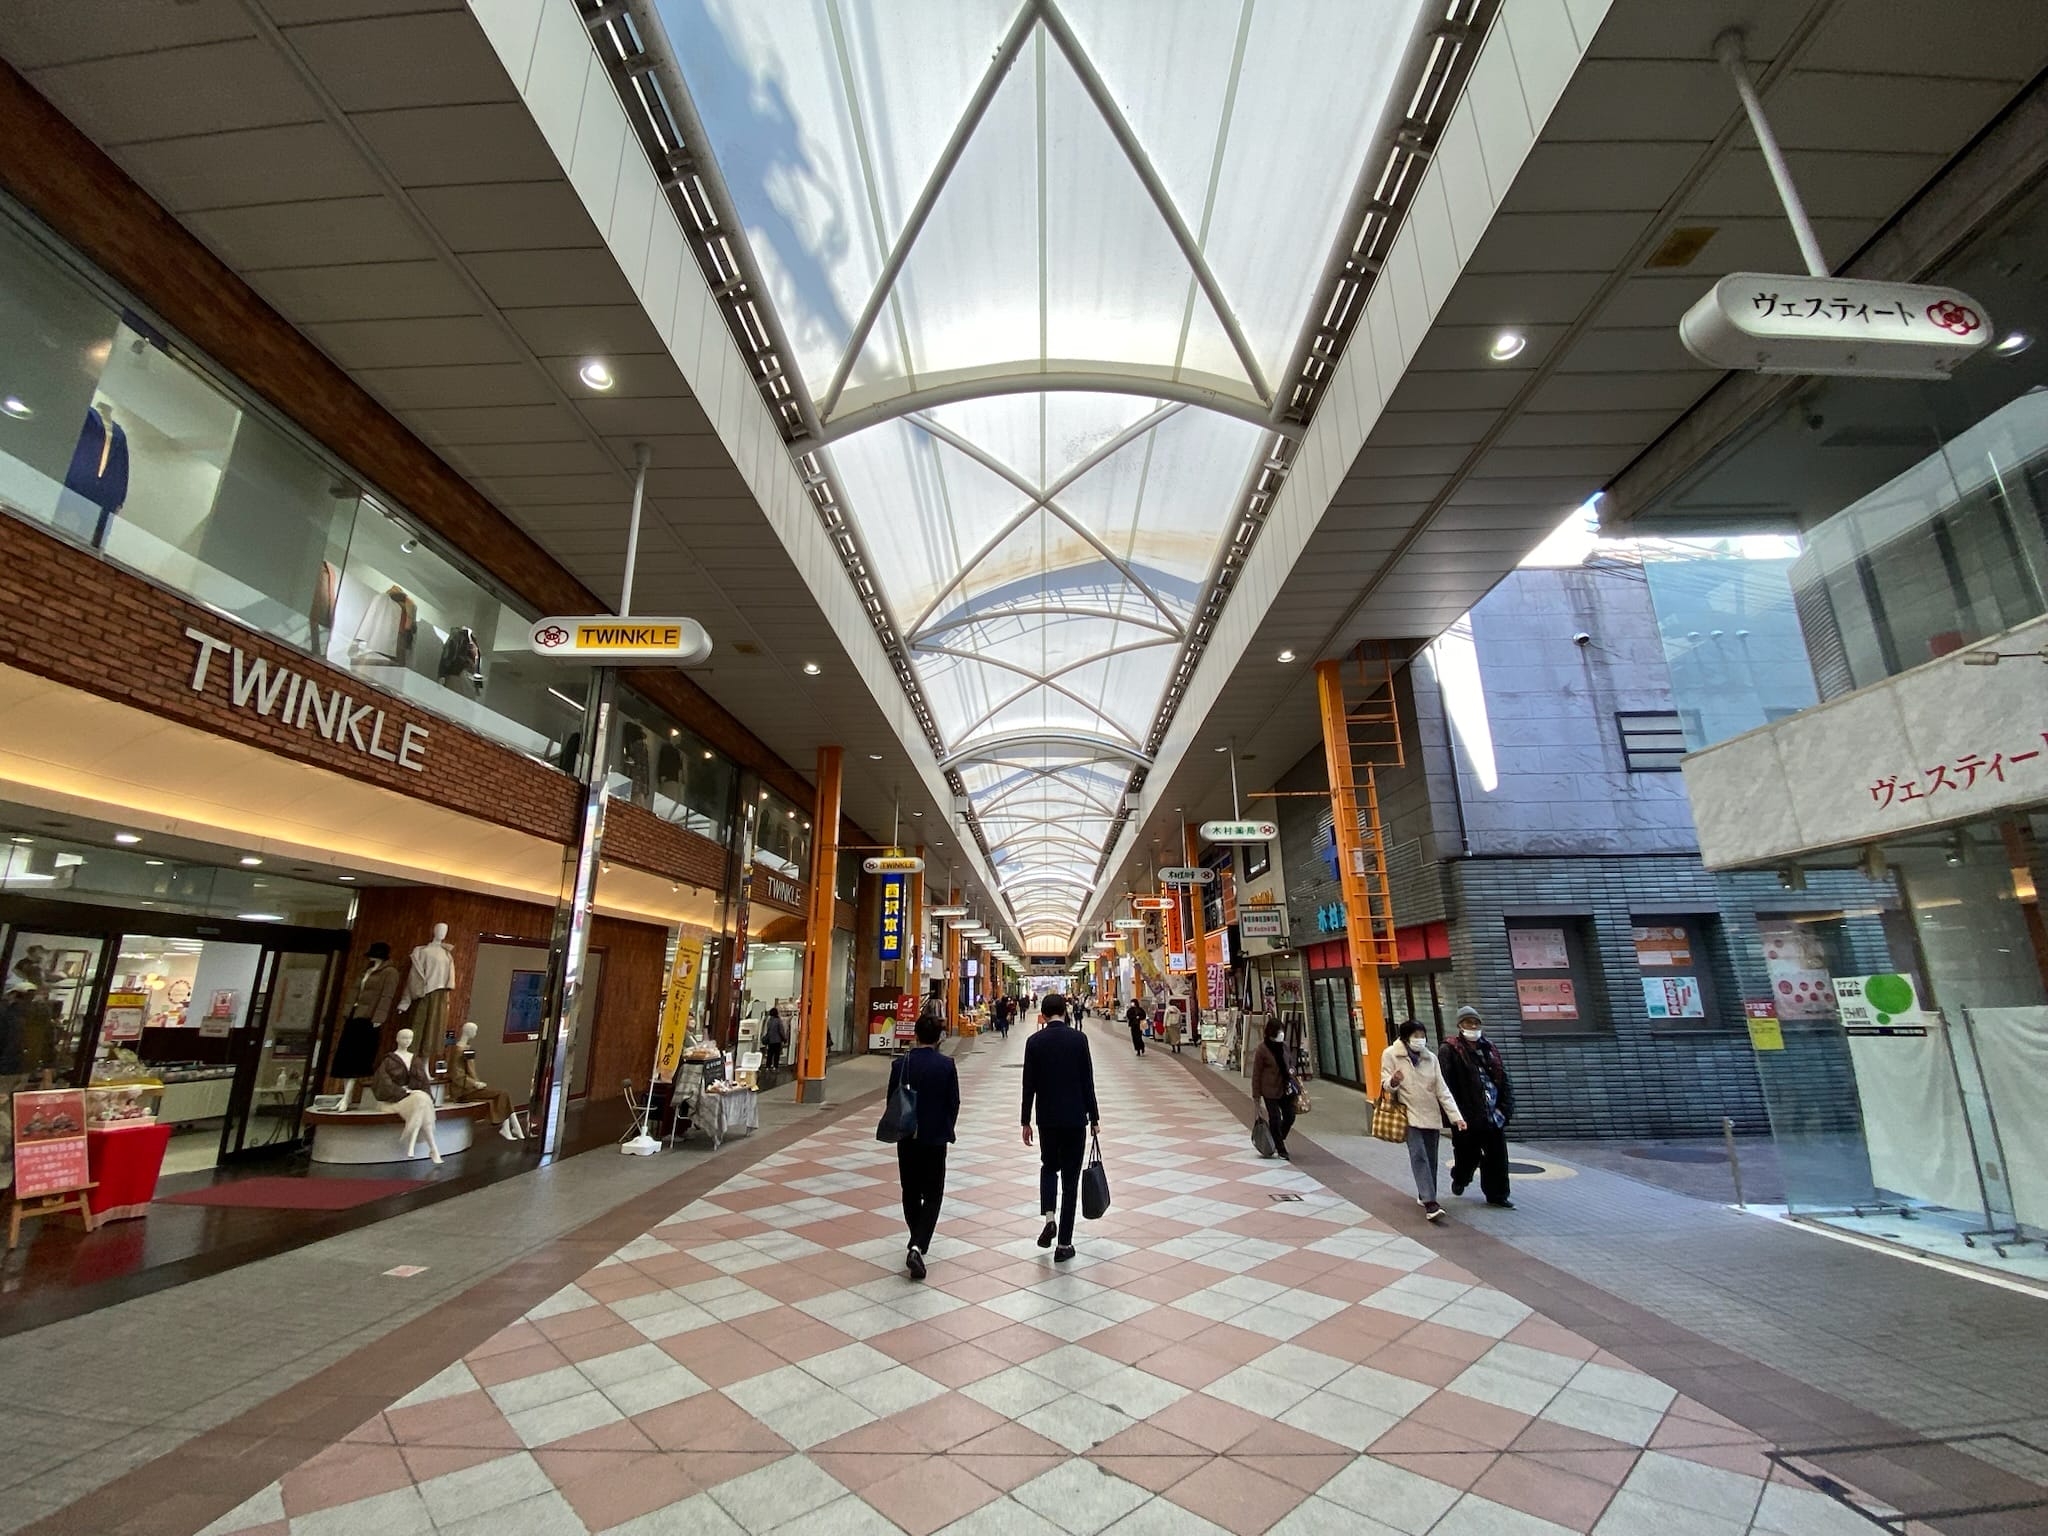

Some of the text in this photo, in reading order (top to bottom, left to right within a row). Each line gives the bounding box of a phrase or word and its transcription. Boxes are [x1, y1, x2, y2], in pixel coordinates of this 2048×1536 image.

[1751, 292, 1915, 326] ヴェスティート
[582, 628, 678, 645] TWINKLE
[185, 626, 430, 772] TWINKLE
[1869, 732, 2048, 811] ヴェスティー
[1212, 826, 1256, 836] 木村薬局
[880, 861, 916, 870] TWINKLE
[767, 875, 801, 907] TWINKLE
[883, 883, 900, 950] 西沢本店
[873, 1001, 899, 1010] Seria
[879, 1037, 891, 1047] 3F
